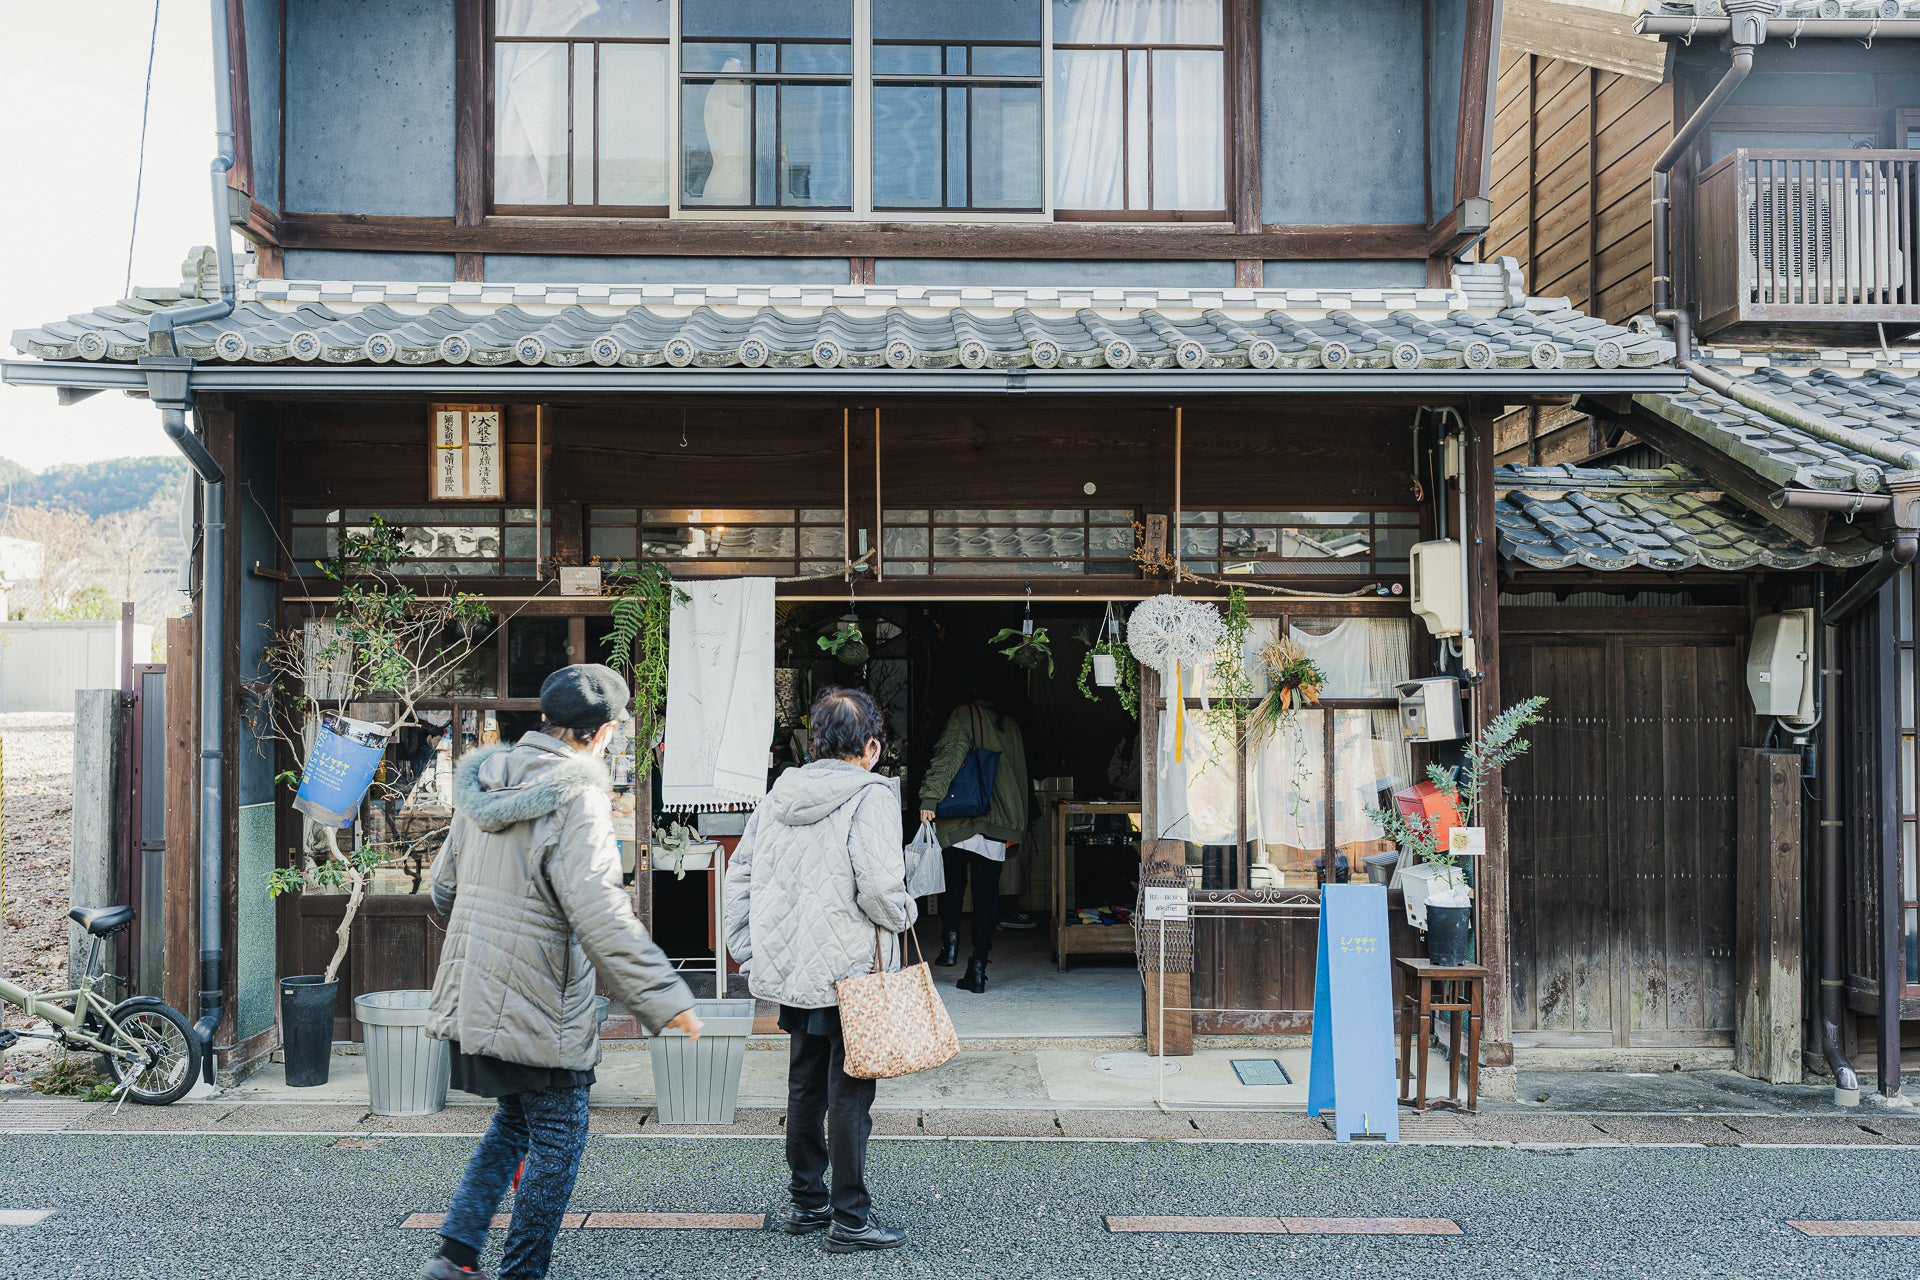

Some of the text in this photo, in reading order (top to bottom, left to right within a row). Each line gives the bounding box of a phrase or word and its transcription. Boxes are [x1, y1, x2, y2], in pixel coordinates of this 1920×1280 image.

[1341, 946, 1376, 954] マーケット
